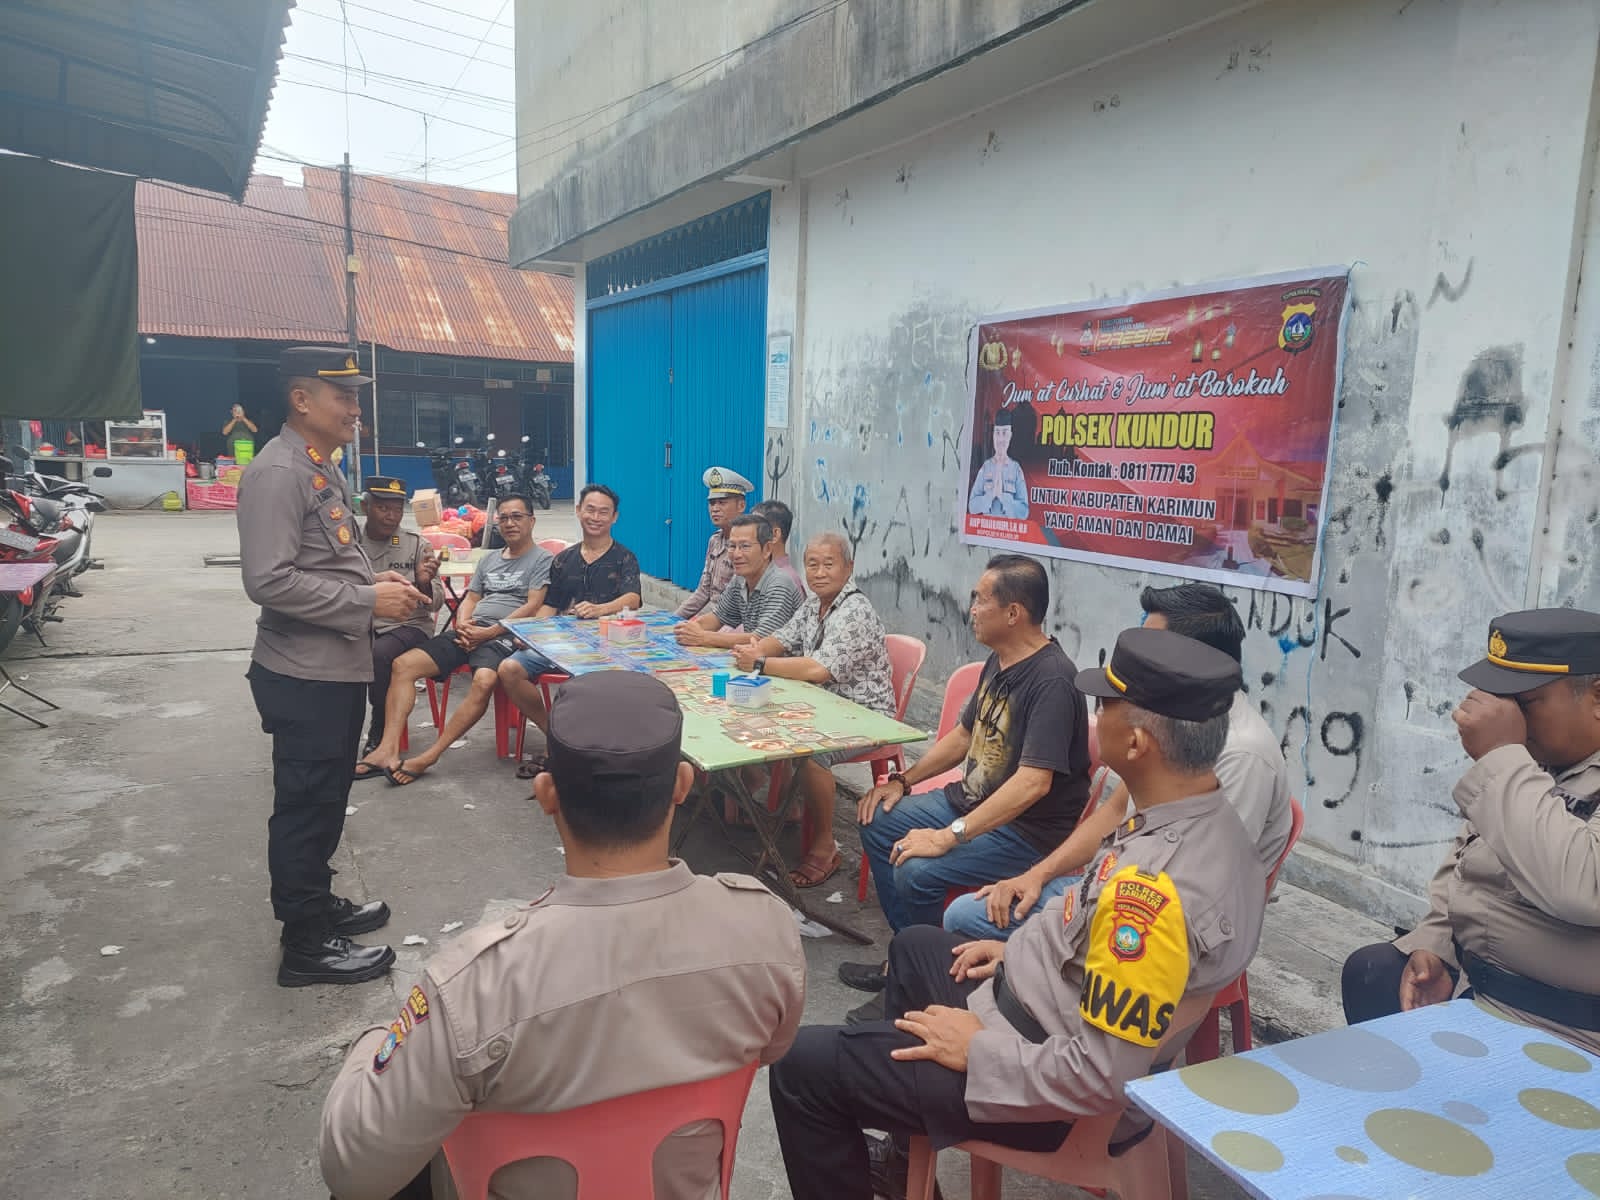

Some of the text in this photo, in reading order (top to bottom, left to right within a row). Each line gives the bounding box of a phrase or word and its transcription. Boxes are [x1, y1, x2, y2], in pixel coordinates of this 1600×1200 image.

[1002, 367, 1288, 408] Jum'at Curhat & Jum'at Barokah
[1041, 412, 1215, 449] POLSEK KUNDUR
[1048, 458, 1073, 477] Hub.
[1073, 460, 1112, 479] Kontak
[1119, 461, 1147, 481] 0811
[1149, 463, 1176, 484] 7777
[1176, 464, 1196, 484] 43
[1031, 487, 1216, 520] UNTUK KABUPATEN KARIMUN
[1044, 511, 1074, 530] YANG
[1076, 515, 1112, 535] AMAN
[1115, 519, 1143, 538] DAN
[1146, 522, 1194, 546] DAMAI
[1120, 882, 1164, 903] POLRES
